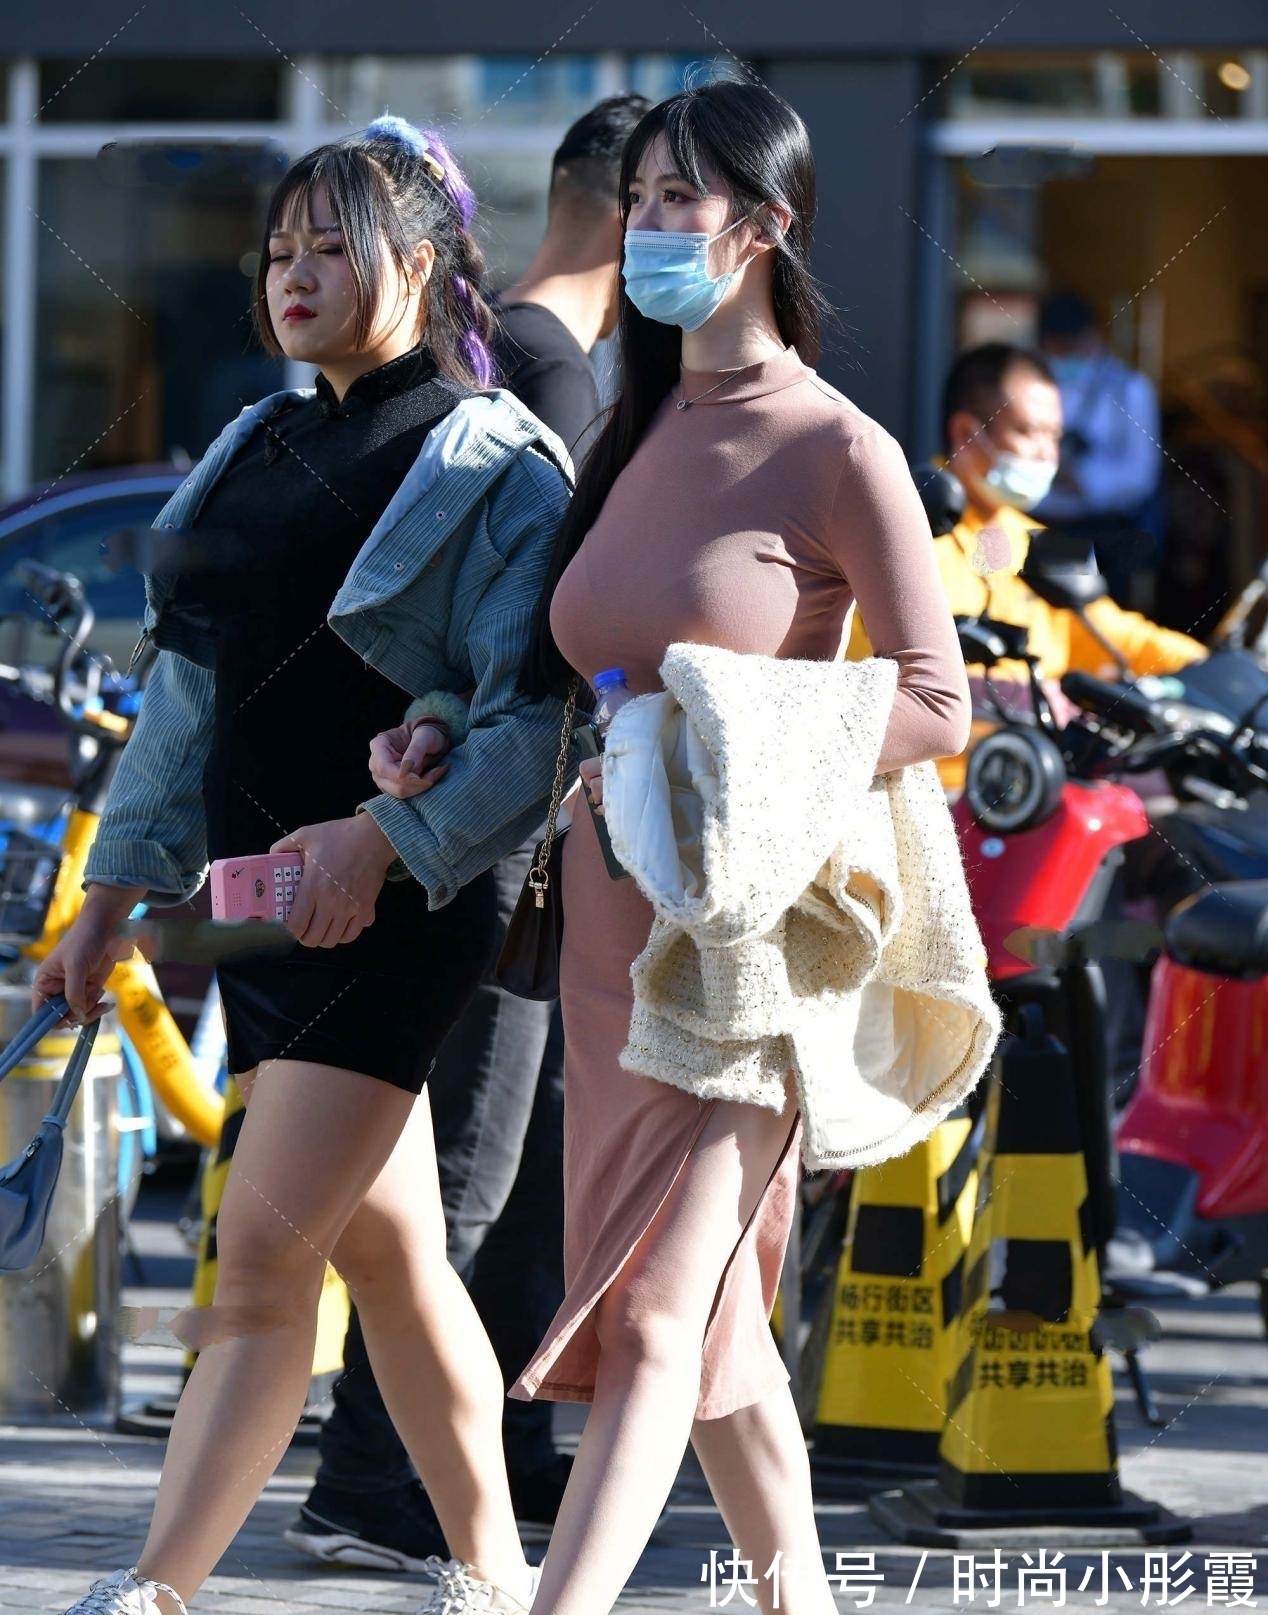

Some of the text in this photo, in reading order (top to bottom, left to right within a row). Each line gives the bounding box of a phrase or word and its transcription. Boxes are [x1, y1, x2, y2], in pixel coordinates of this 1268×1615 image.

[835, 1318, 934, 1349] 共享共治
[979, 1359, 1088, 1388] 共享共治
